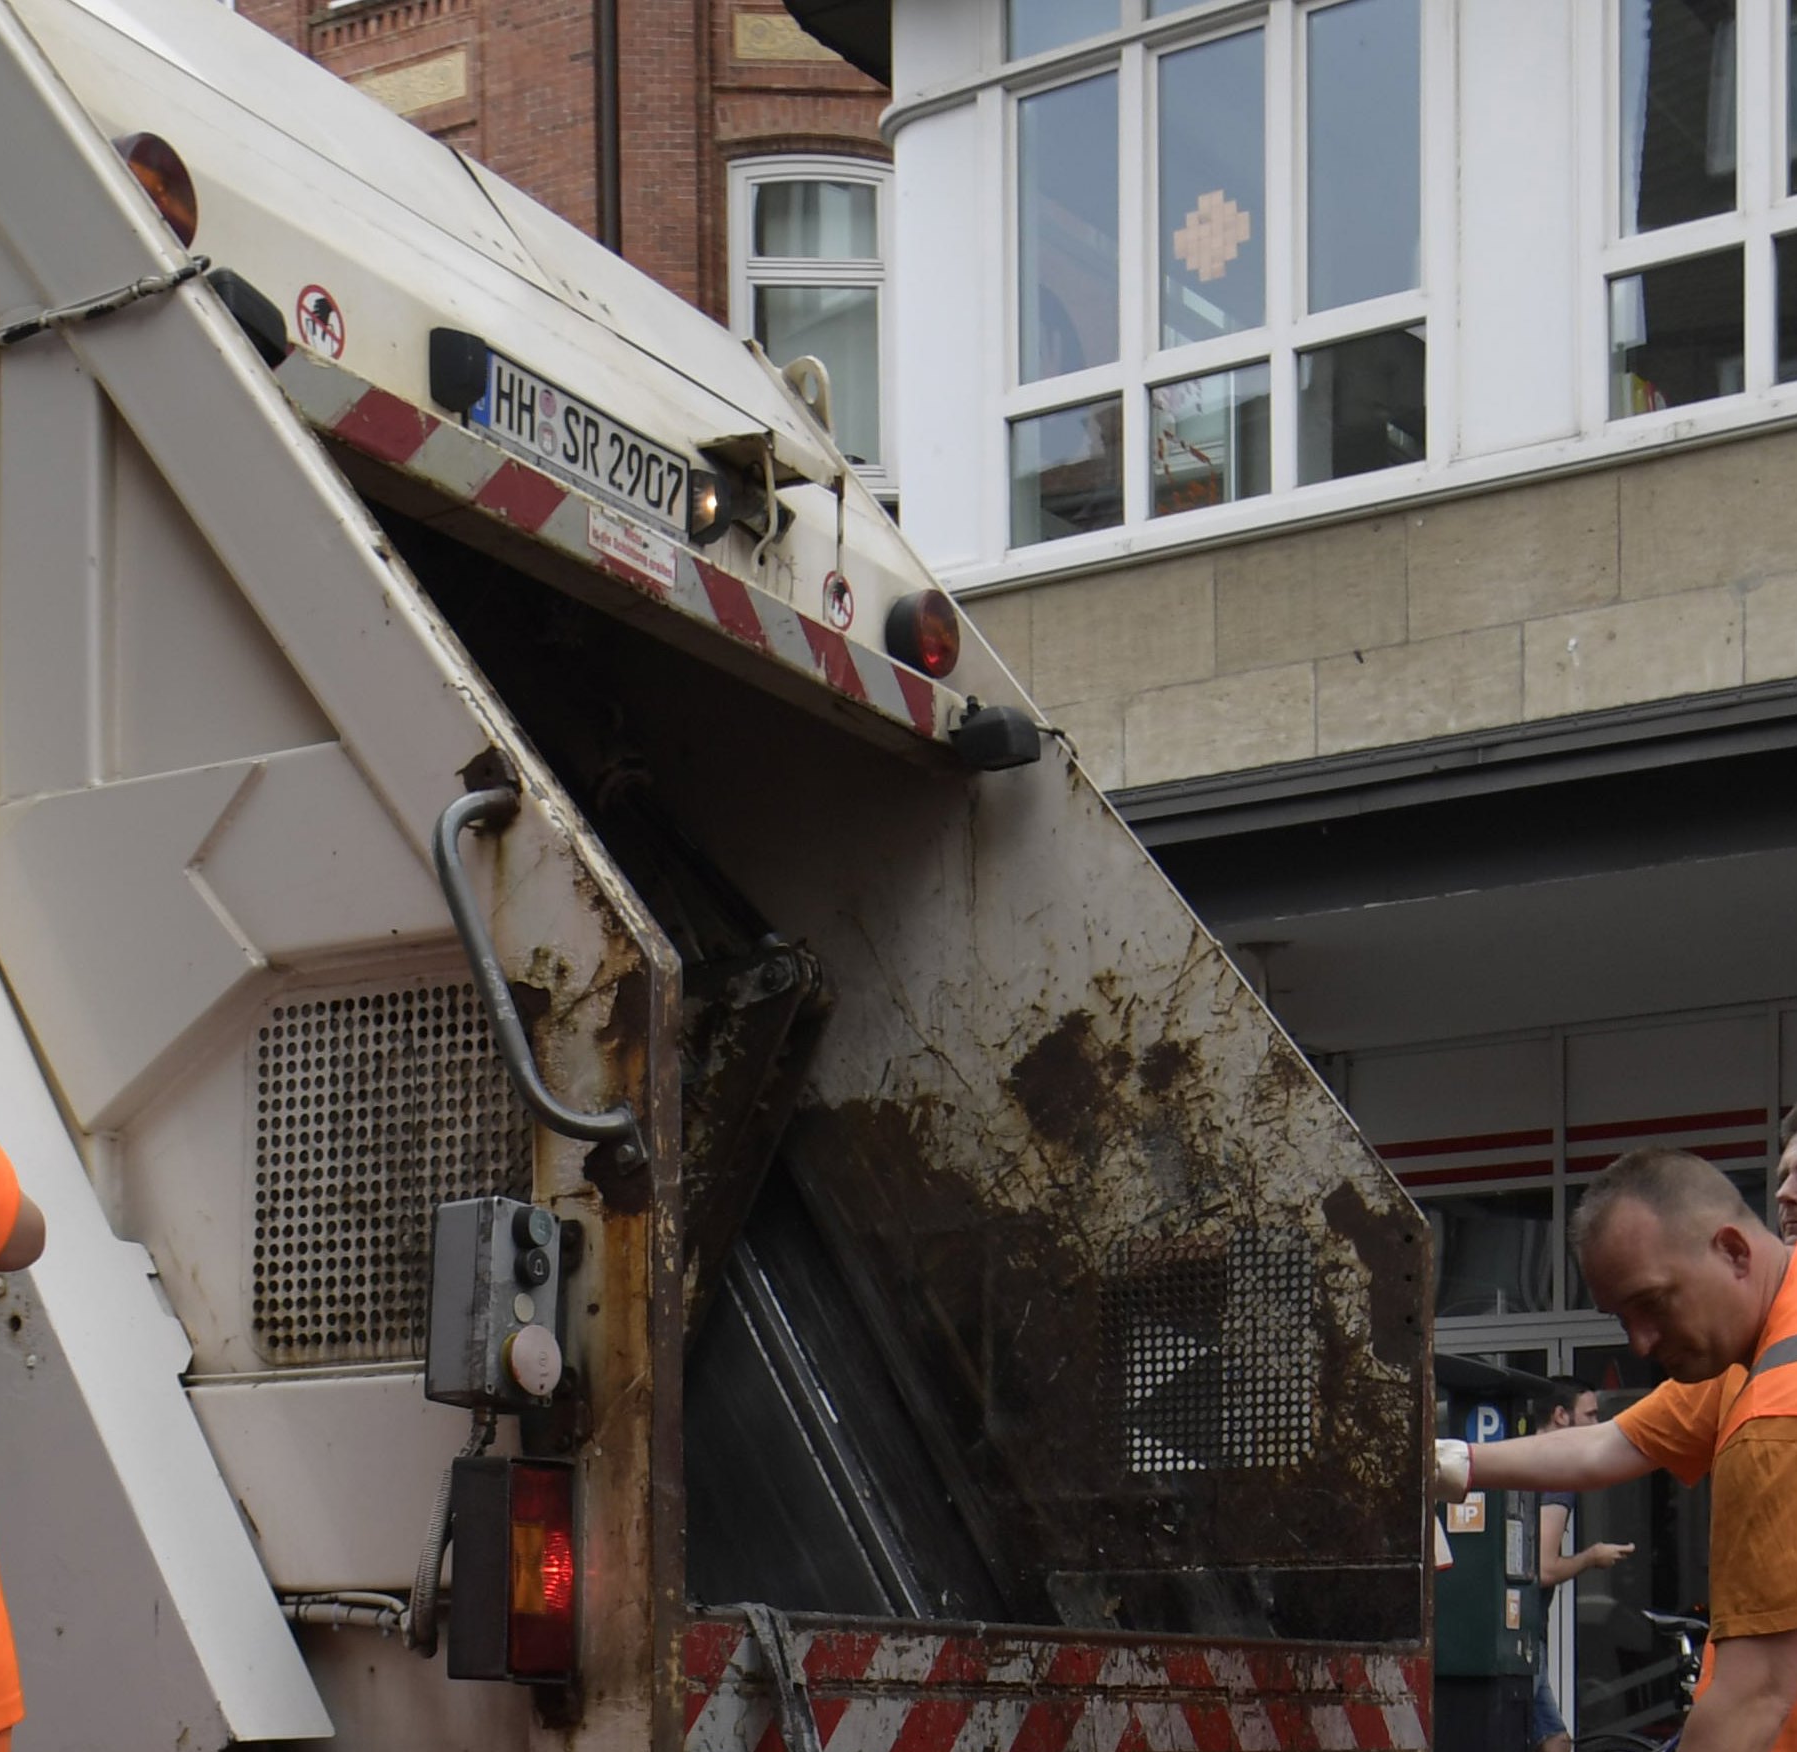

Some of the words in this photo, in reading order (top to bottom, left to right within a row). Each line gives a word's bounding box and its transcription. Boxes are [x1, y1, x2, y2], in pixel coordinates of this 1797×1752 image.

[496, 365, 536, 442] HH
[562, 405, 600, 478] SR
[608, 432, 684, 517] 2907
[1477, 1405, 1500, 1443] P
